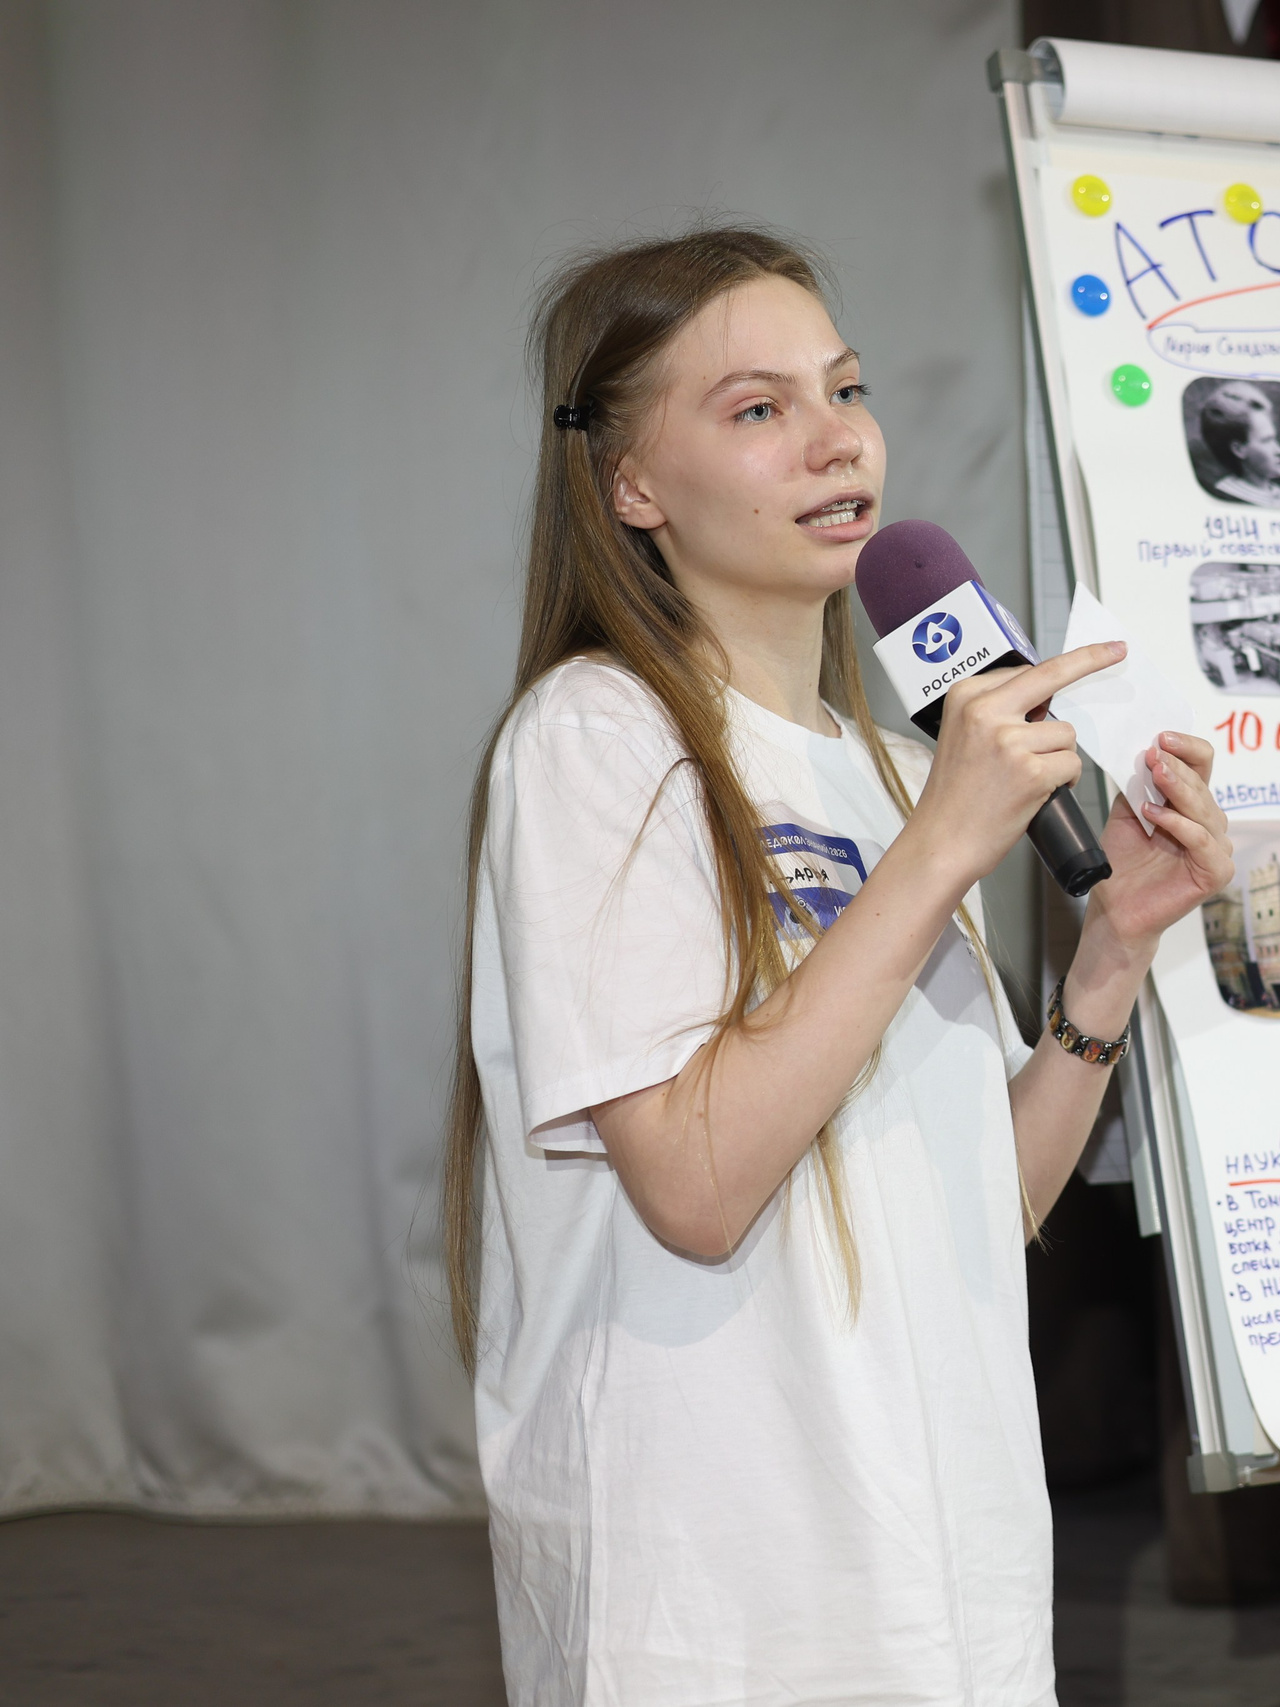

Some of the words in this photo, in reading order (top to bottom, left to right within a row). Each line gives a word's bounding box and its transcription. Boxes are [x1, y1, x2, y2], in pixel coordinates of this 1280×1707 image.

[1205, 516, 1260, 540] 1944
[921, 646, 991, 697] РОСАТОМ
[1214, 710, 1263, 755] 10
[828, 846, 848, 859] 2026
